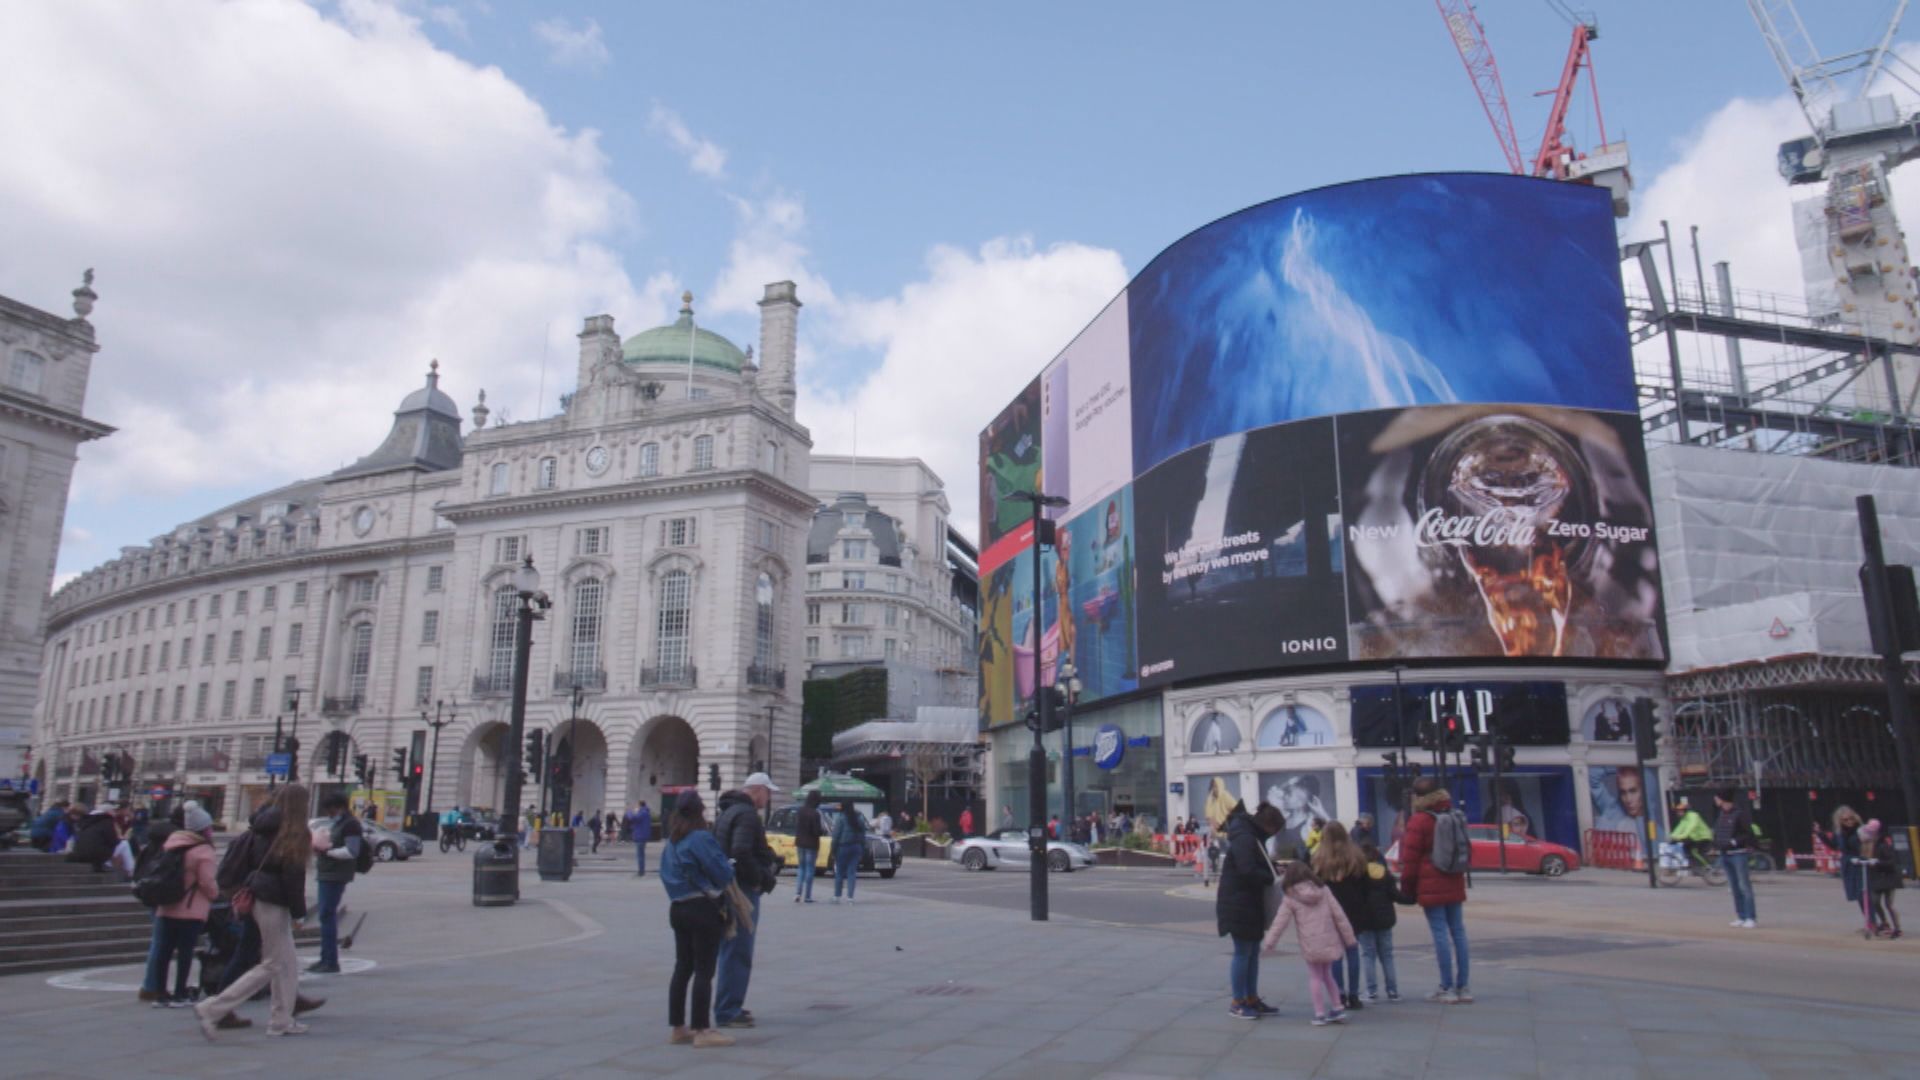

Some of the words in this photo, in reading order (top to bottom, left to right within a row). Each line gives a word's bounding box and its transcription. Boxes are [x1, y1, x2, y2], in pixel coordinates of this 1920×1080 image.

[1349, 524, 1399, 542] New
[1413, 506, 1536, 548] Coca-Cola
[1547, 519, 1591, 538] Zero
[1594, 521, 1649, 543] Sugar
[1161, 570, 1172, 585] by
[1187, 560, 1210, 575] way
[1210, 555, 1229, 569] we
[1230, 545, 1270, 561] move
[1281, 636, 1337, 654] IONIQ
